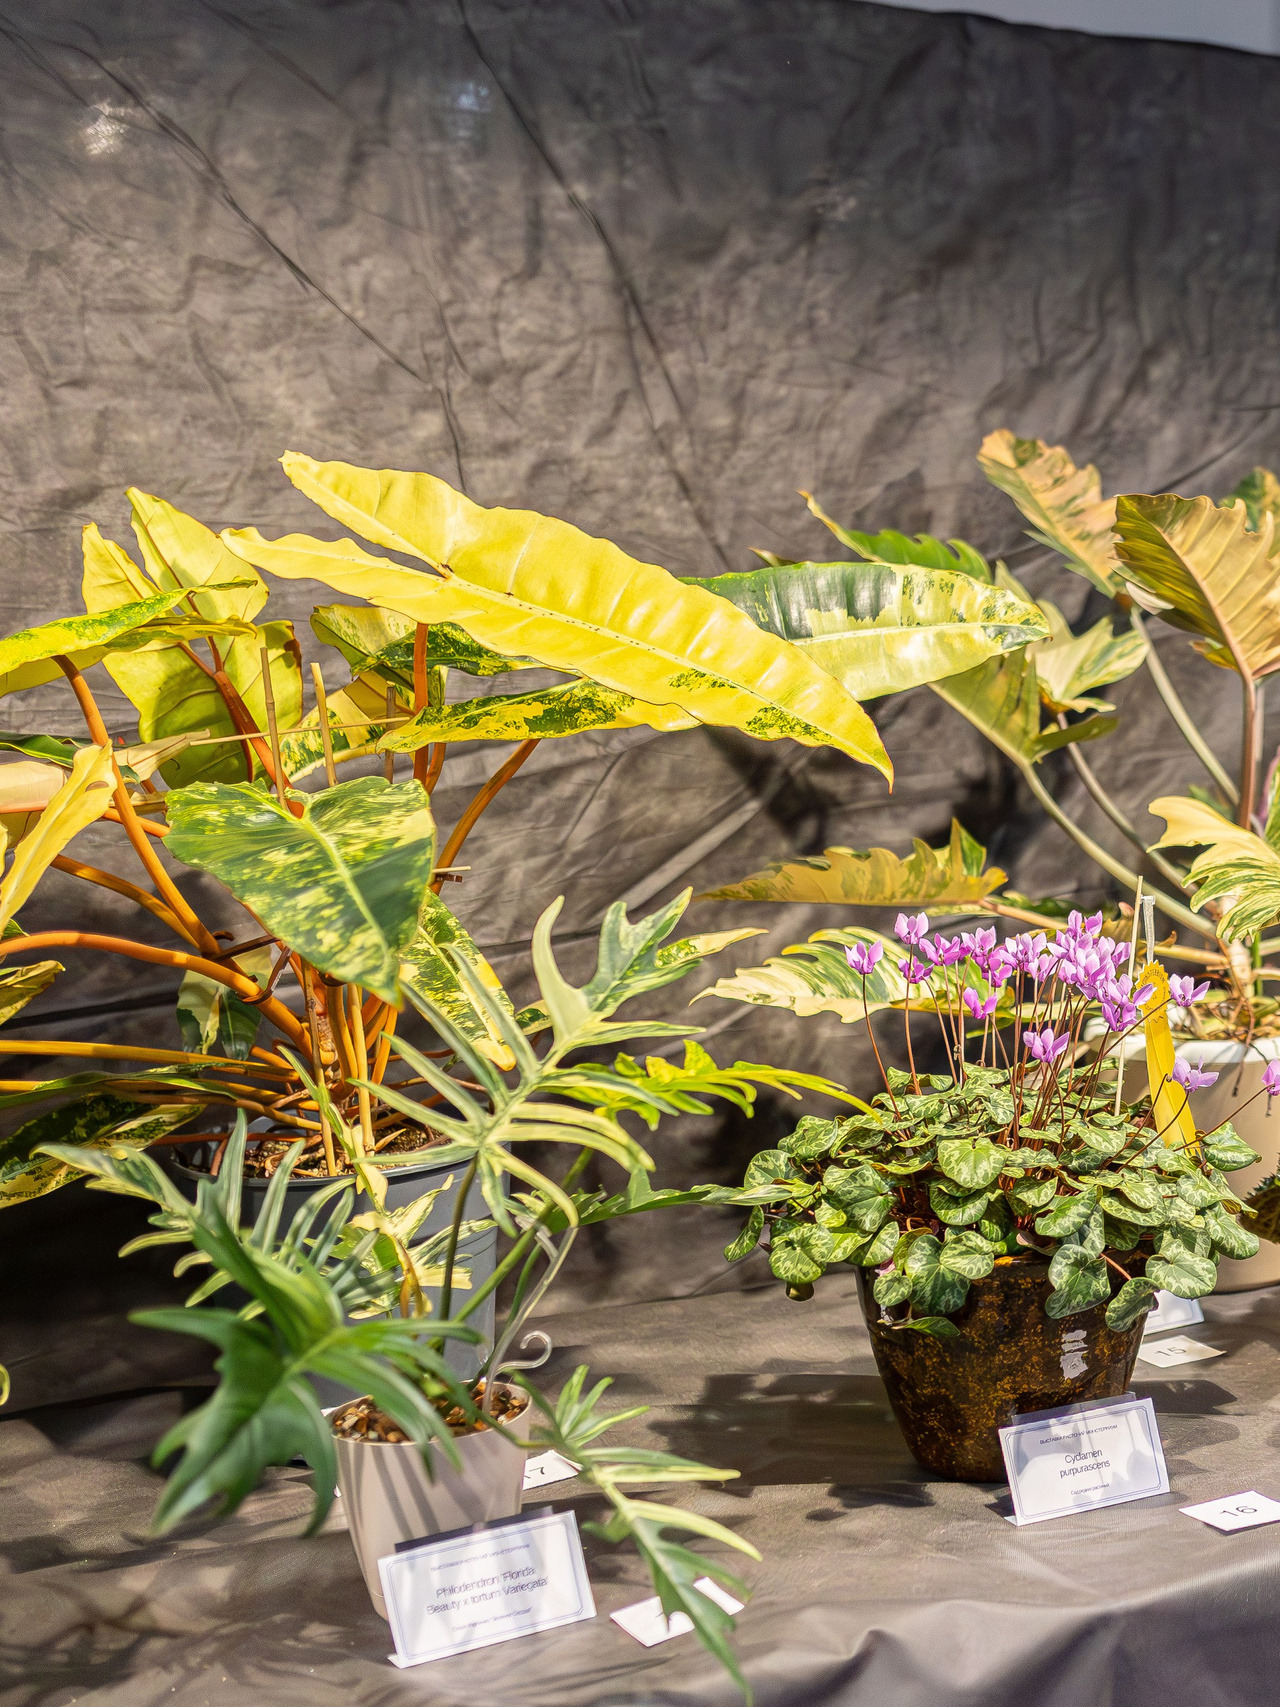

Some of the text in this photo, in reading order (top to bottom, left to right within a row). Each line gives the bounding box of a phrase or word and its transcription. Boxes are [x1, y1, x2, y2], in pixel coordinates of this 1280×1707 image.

[1155, 1346, 1187, 1357] 15
[1059, 1460, 1111, 1478] purpurascens
[1220, 1505, 1258, 1517] 16
[435, 1574, 499, 1599] Philodendron
[426, 1599, 461, 1616] Beauty
[463, 1598, 469, 1606] x
